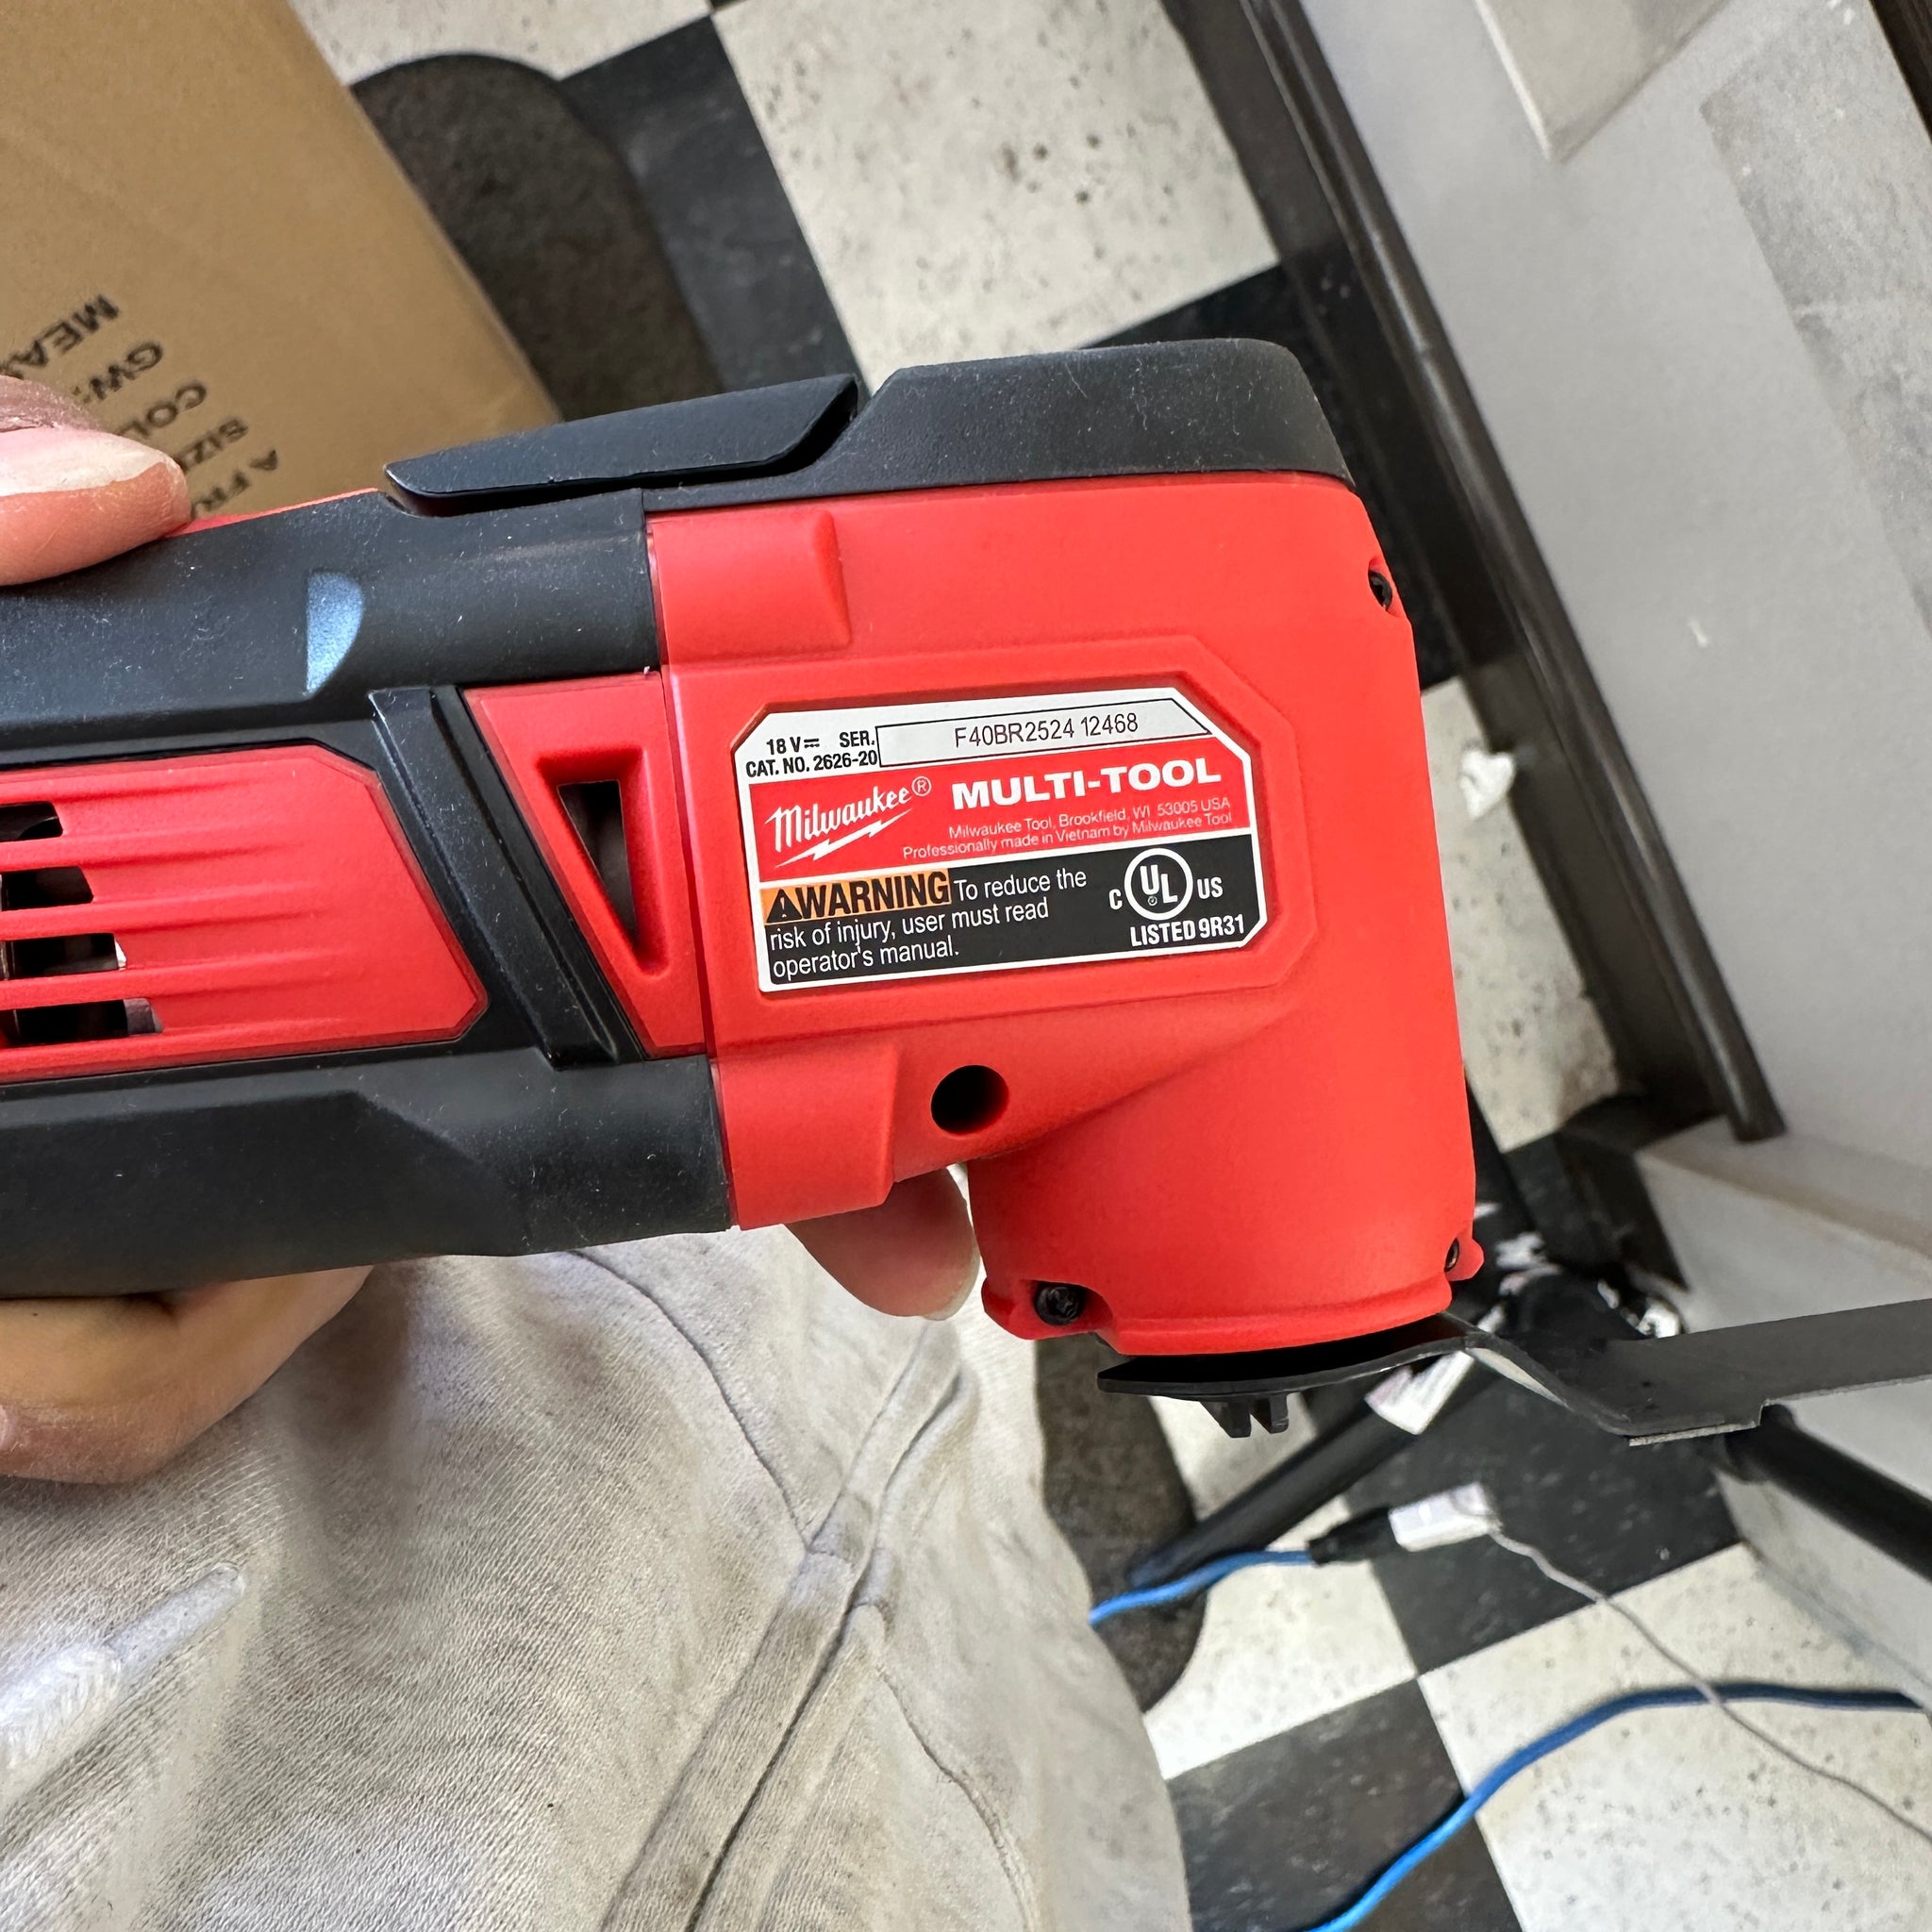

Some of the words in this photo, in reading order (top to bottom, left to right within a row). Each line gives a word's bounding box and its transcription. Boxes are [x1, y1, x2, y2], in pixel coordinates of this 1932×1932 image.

[250, 449, 278, 471] A
[767, 739, 787, 755] 18
[840, 730, 874, 748] SER.
[954, 717, 1075, 748] F40BR2524
[1080, 712, 1139, 737] 12468
[745, 758, 779, 778] CAT.
[784, 756, 809, 774] NO.
[813, 750, 877, 771] 2626-20
[951, 758, 1222, 810] MULTI-TOOL
[903, 839, 998, 860] Professionally
[1000, 833, 1039, 848] made
[1041, 830, 1054, 844] in
[1056, 825, 1109, 842] Vietnam
[1113, 824, 1129, 840] by
[1132, 817, 1203, 834] Milwaukee
[1206, 811, 1232, 825] Tool
[948, 822, 1022, 840] Milwaukee
[1132, 806, 1150, 820] WI
[1157, 800, 1198, 817] 53005
[1201, 796, 1231, 812] USA
[795, 871, 949, 920] WARNING
[954, 879, 978, 901] To
[985, 873, 1051, 897] reduce
[1057, 867, 1087, 890] the
[1197, 876, 1224, 899] US
[770, 926, 807, 950] risk
[811, 924, 831, 946] of
[837, 919, 896, 946] injury,
[902, 912, 945, 935] user
[952, 907, 1001, 929] must
[1006, 896, 1050, 923] read
[1130, 920, 1196, 947] LISTED
[1198, 914, 1244, 939] 9R31
[773, 945, 874, 981] operator's
[880, 936, 960, 963] manual.
